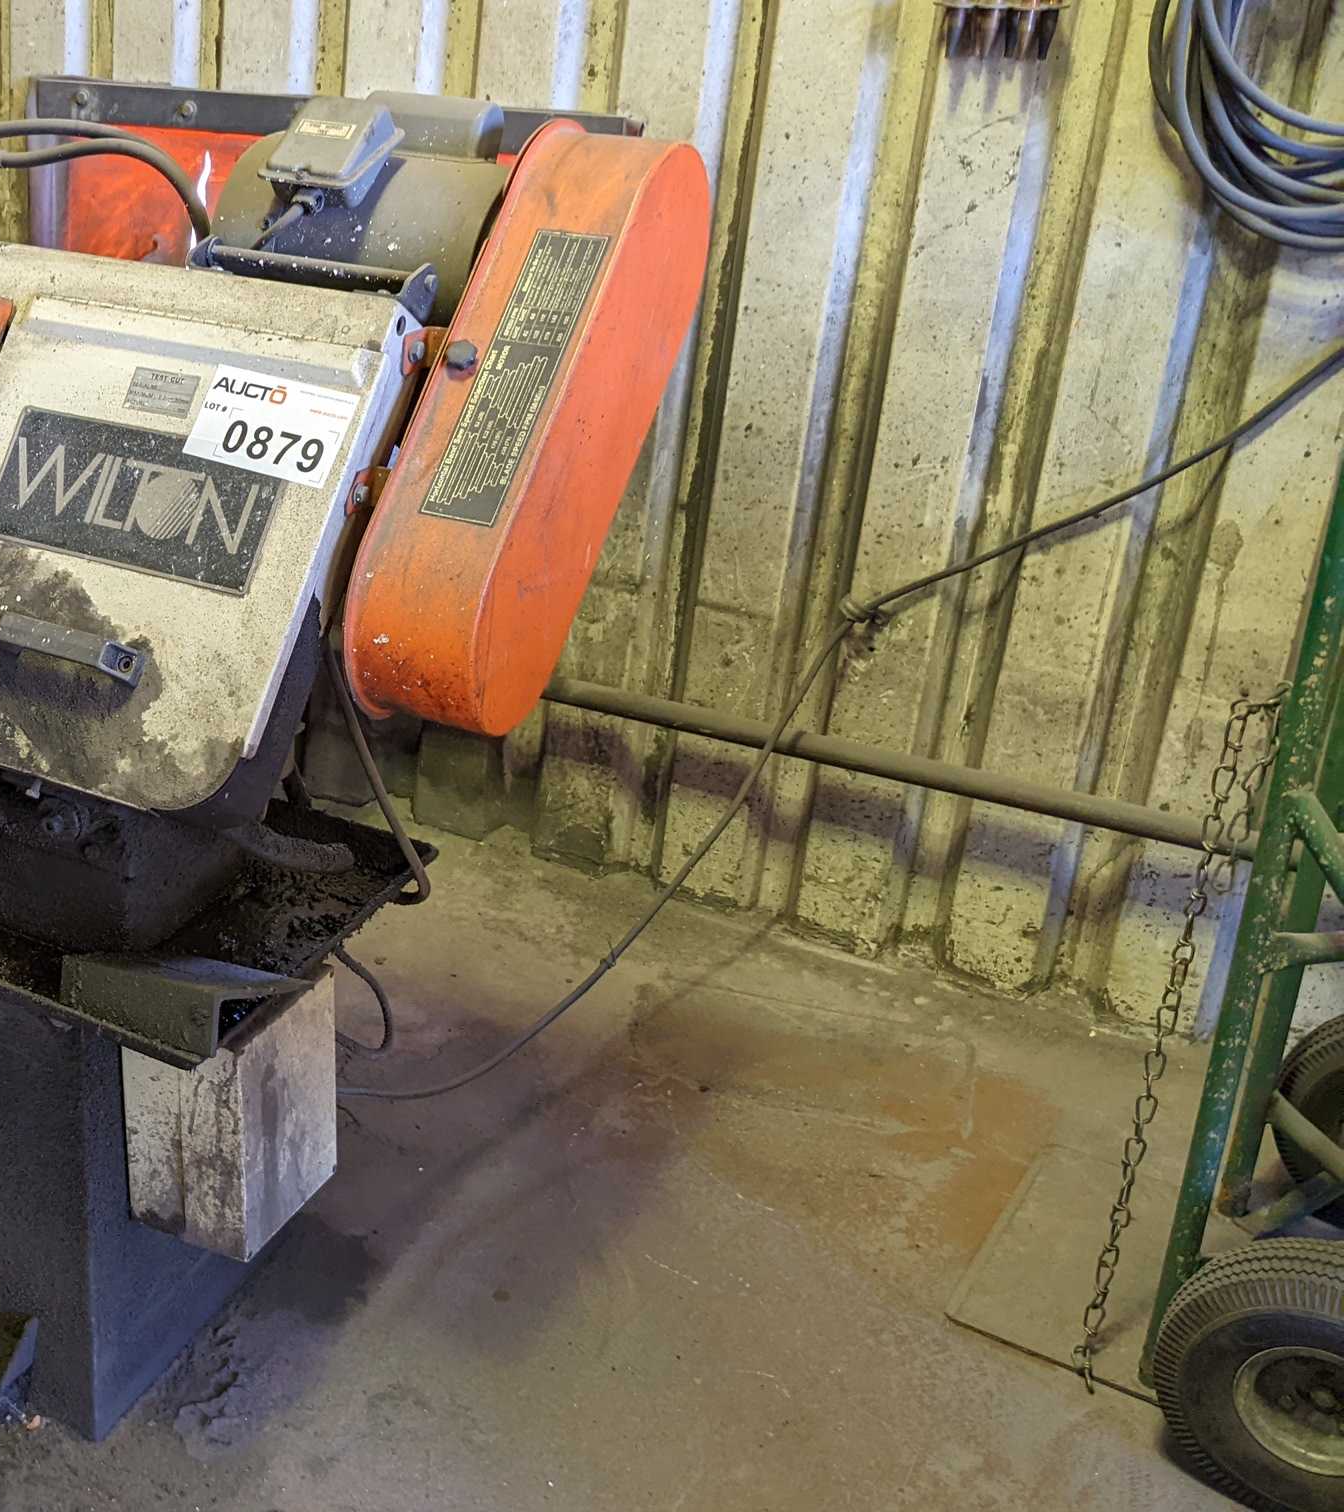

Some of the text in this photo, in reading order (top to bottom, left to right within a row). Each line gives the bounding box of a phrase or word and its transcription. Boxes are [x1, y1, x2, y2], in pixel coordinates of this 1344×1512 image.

[495, 345, 511, 369] MOTOR
[204, 401, 220, 412] LOT
[222, 420, 324, 473] 0879
[428, 464, 449, 501] Horizontal
[460, 404, 476, 427] Speed
[499, 457, 515, 485] BLADE
[510, 430, 526, 457] SPEED
[19, 436, 258, 554] WILTON
